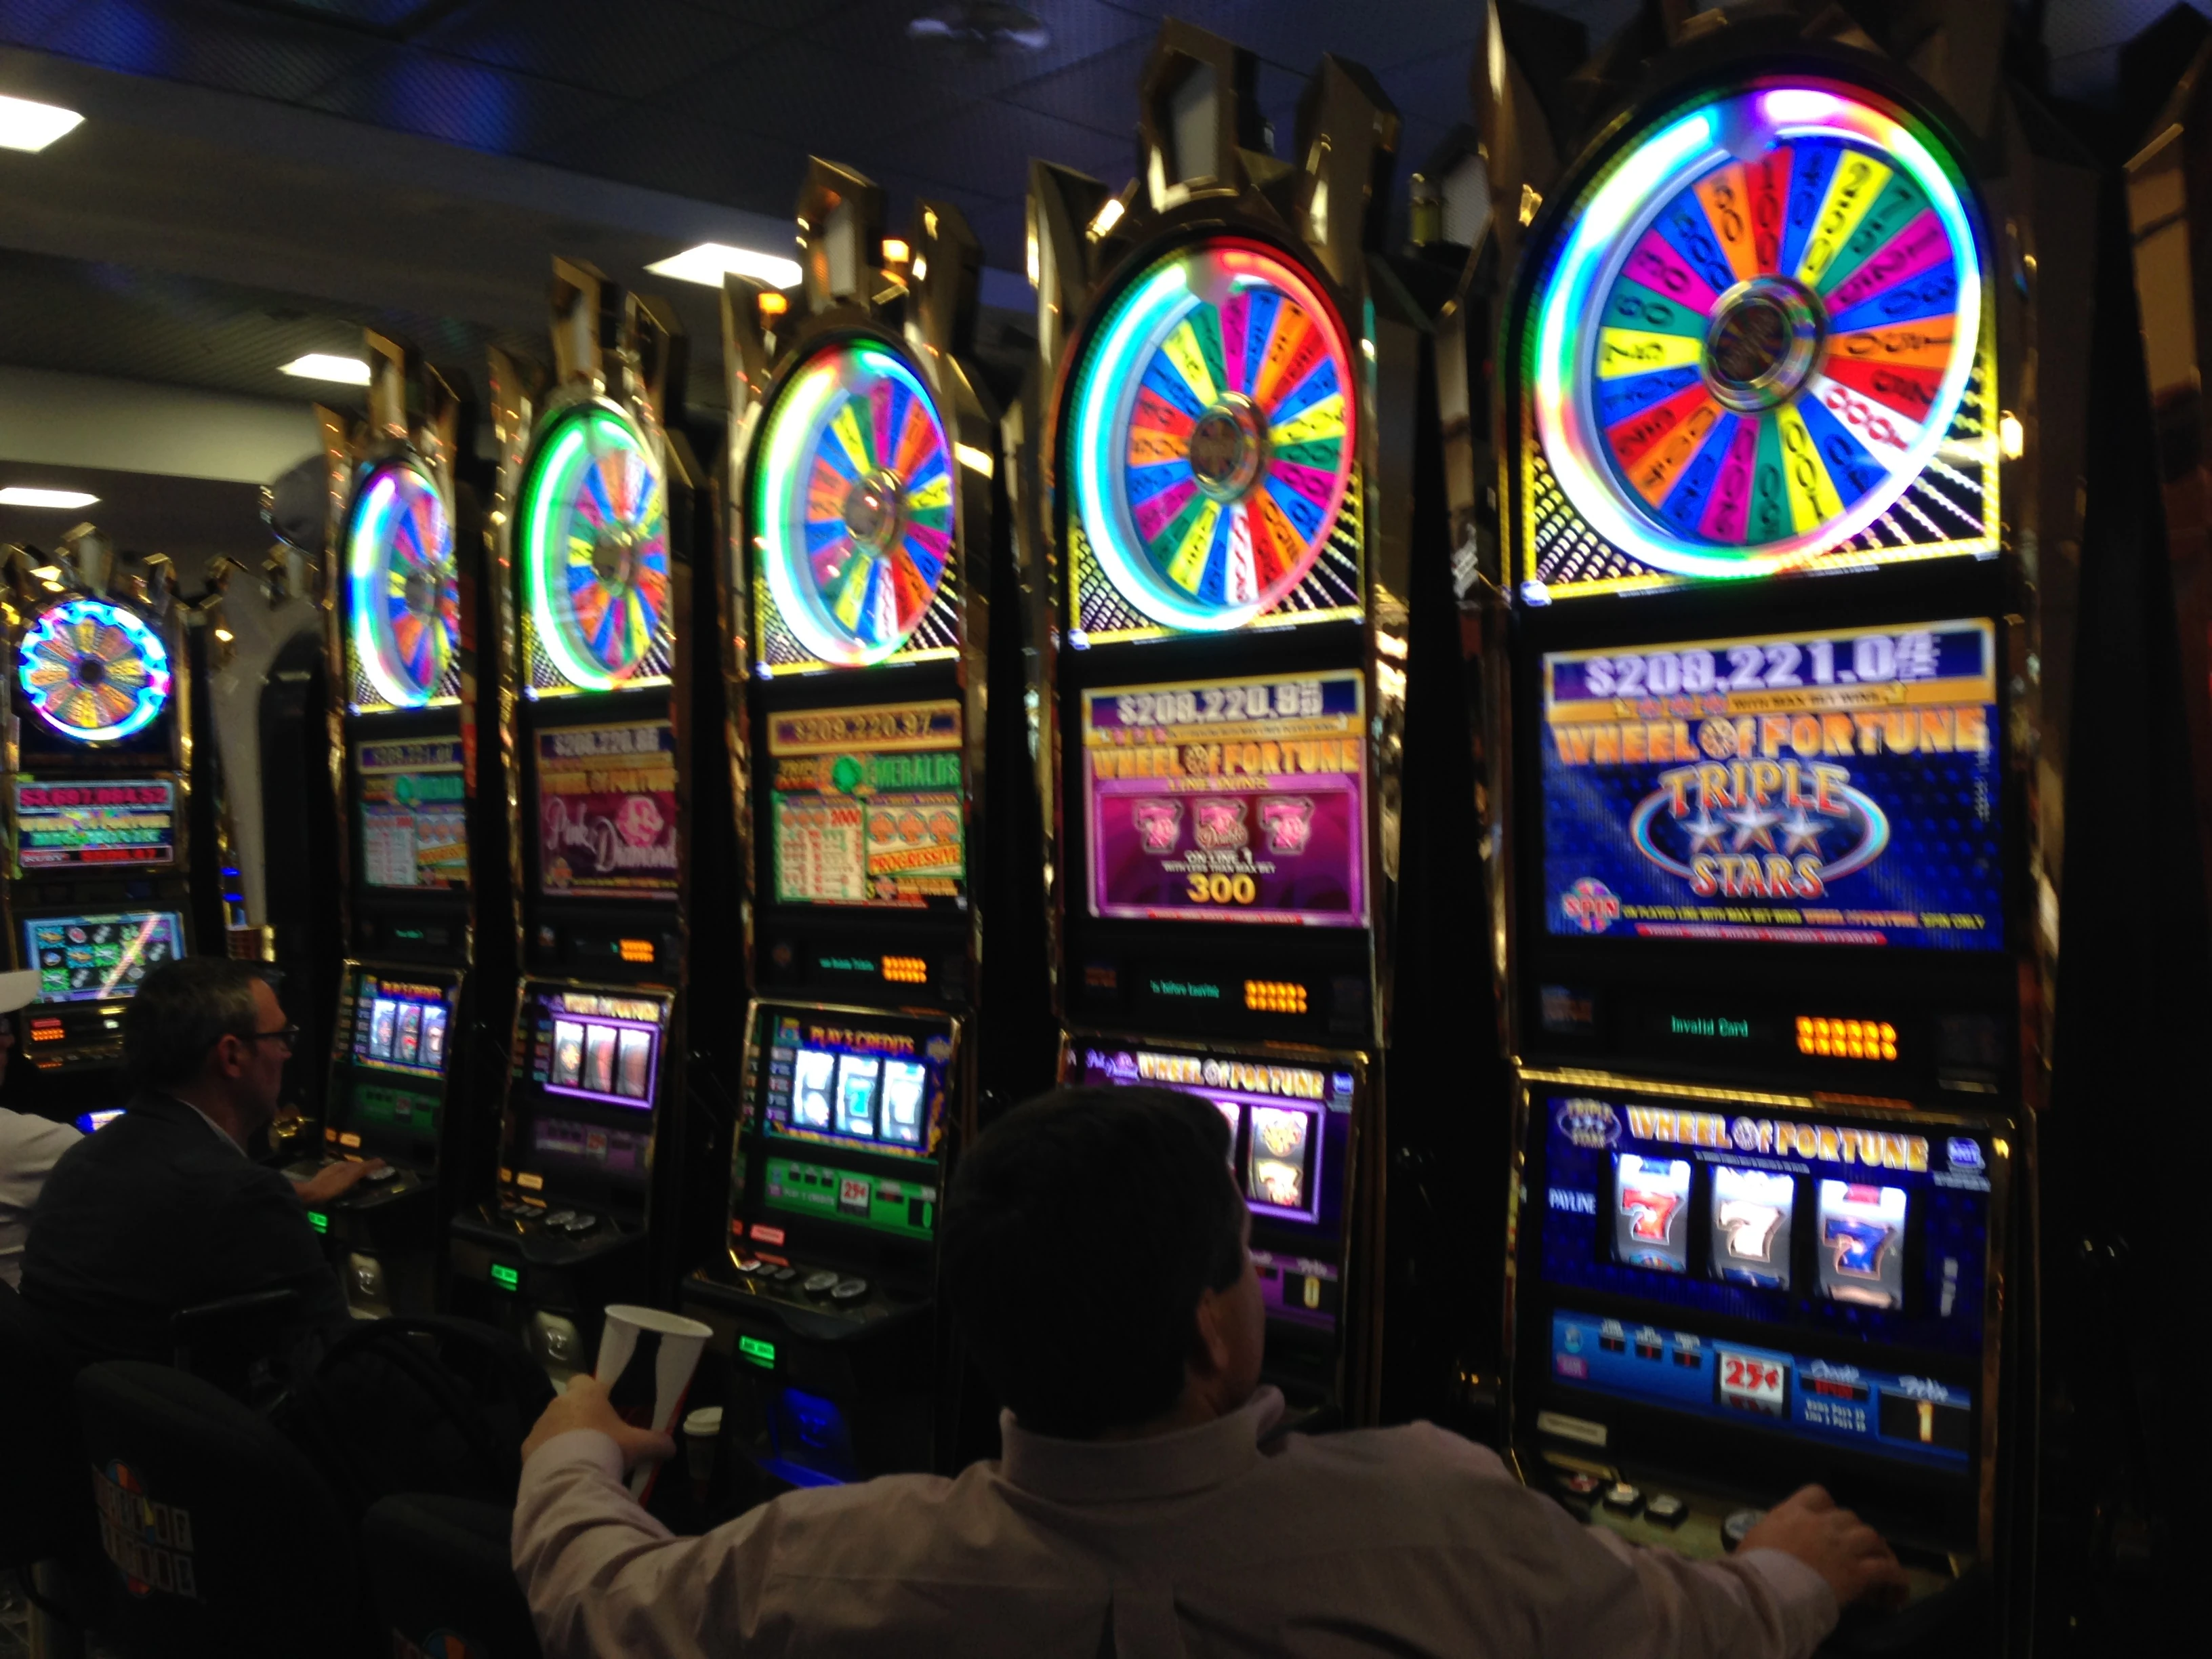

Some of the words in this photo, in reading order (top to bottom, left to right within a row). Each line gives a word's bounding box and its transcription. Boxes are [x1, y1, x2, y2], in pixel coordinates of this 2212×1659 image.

[1805, 162, 1872, 272] 250
[1556, 719, 1700, 764] WHEEL
[1763, 705, 1987, 758] FORTUNE
[1093, 747, 1185, 779] WHEEL
[1224, 739, 1359, 774] FORTUNE
[1169, 777, 1212, 792] LINE
[1220, 777, 1269, 791] WINS
[1659, 759, 1850, 818] TRIPLE
[1185, 850, 1207, 863] ON
[1208, 851, 1238, 864] LINE
[1691, 853, 1826, 898] STARS
[1187, 872, 1256, 904] 300
[1563, 892, 1620, 920] SPIN
[855, 1029, 915, 1056] CREDITS
[1671, 1016, 1715, 1037] Invalid
[1718, 1018, 1748, 1038] Card
[1136, 1051, 1204, 1085] WHEEL
[1230, 1061, 1324, 1099] FORTUNE
[1626, 1105, 1733, 1149] WHEEL
[1775, 1120, 1929, 1172] FORTUNE
[1549, 1188, 1596, 1214] PAYLINE
[1725, 1357, 1780, 1391] 25¢
[1917, 1401, 1934, 1443] 1
